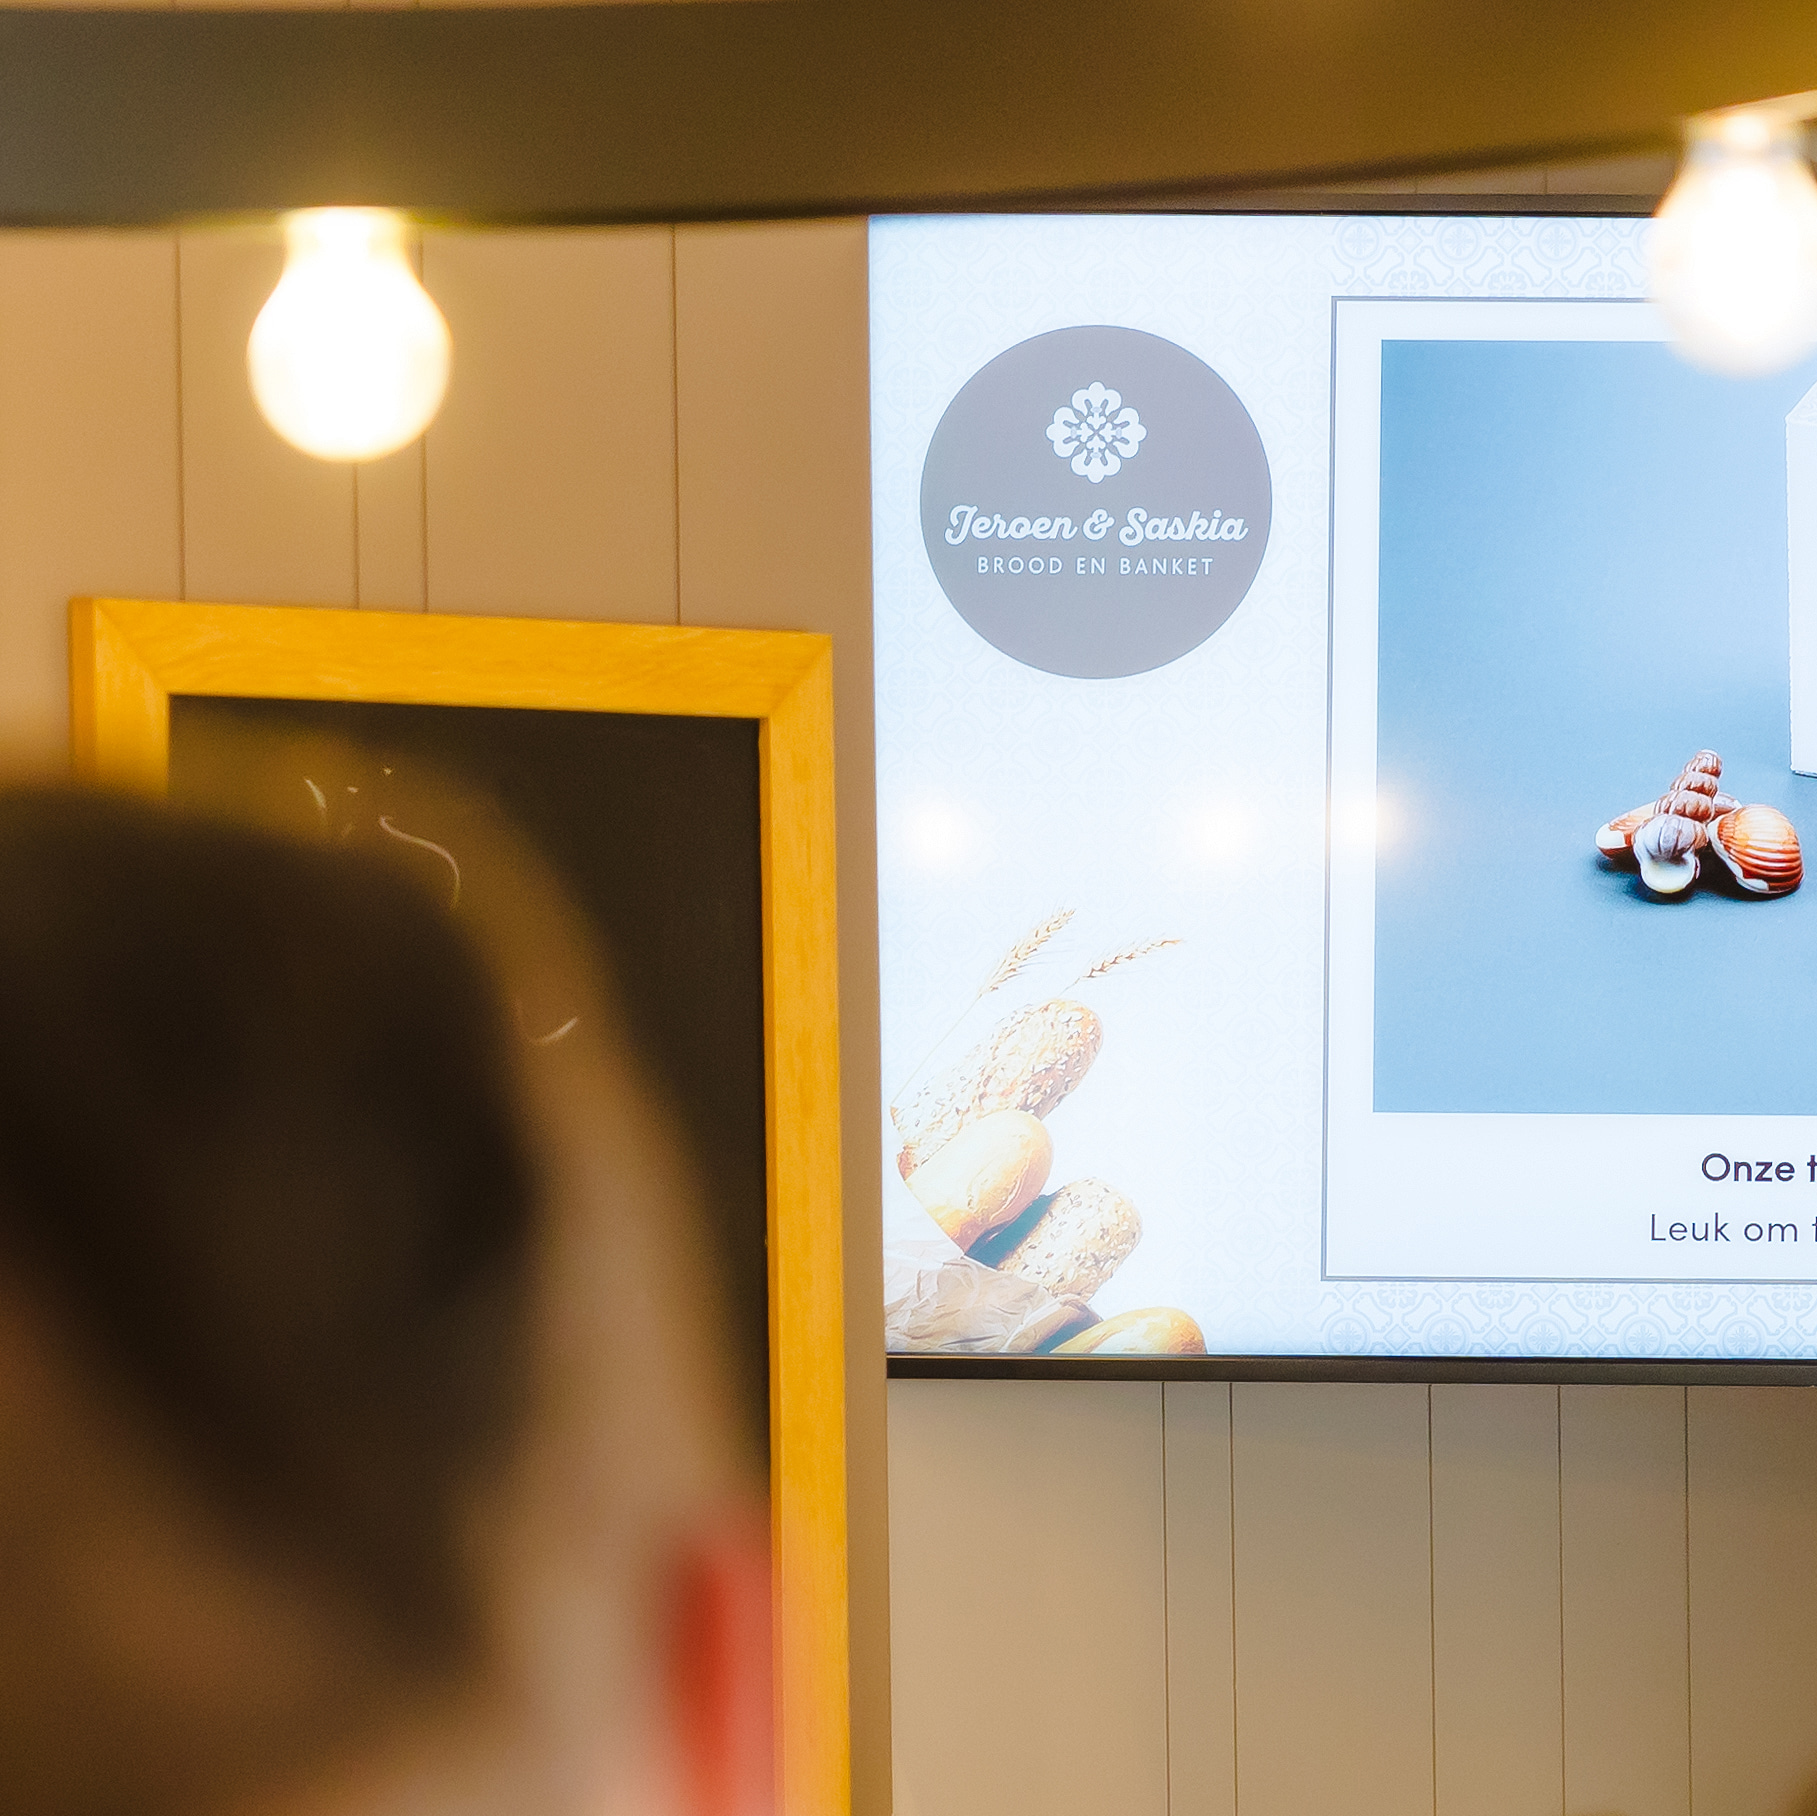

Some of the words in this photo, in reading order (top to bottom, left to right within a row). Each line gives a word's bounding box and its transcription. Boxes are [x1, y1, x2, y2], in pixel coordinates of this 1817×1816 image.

[944, 505, 1078, 546] Jeroen
[1083, 508, 1114, 540] &
[1118, 507, 1249, 546] Saskia
[977, 556, 1063, 575] BROOD
[1076, 557, 1105, 575] EN
[1119, 558, 1213, 575] BANKET
[1701, 1153, 1795, 1182] Onze
[1650, 1213, 1731, 1242] Leuk
[1744, 1222, 1798, 1242] om
